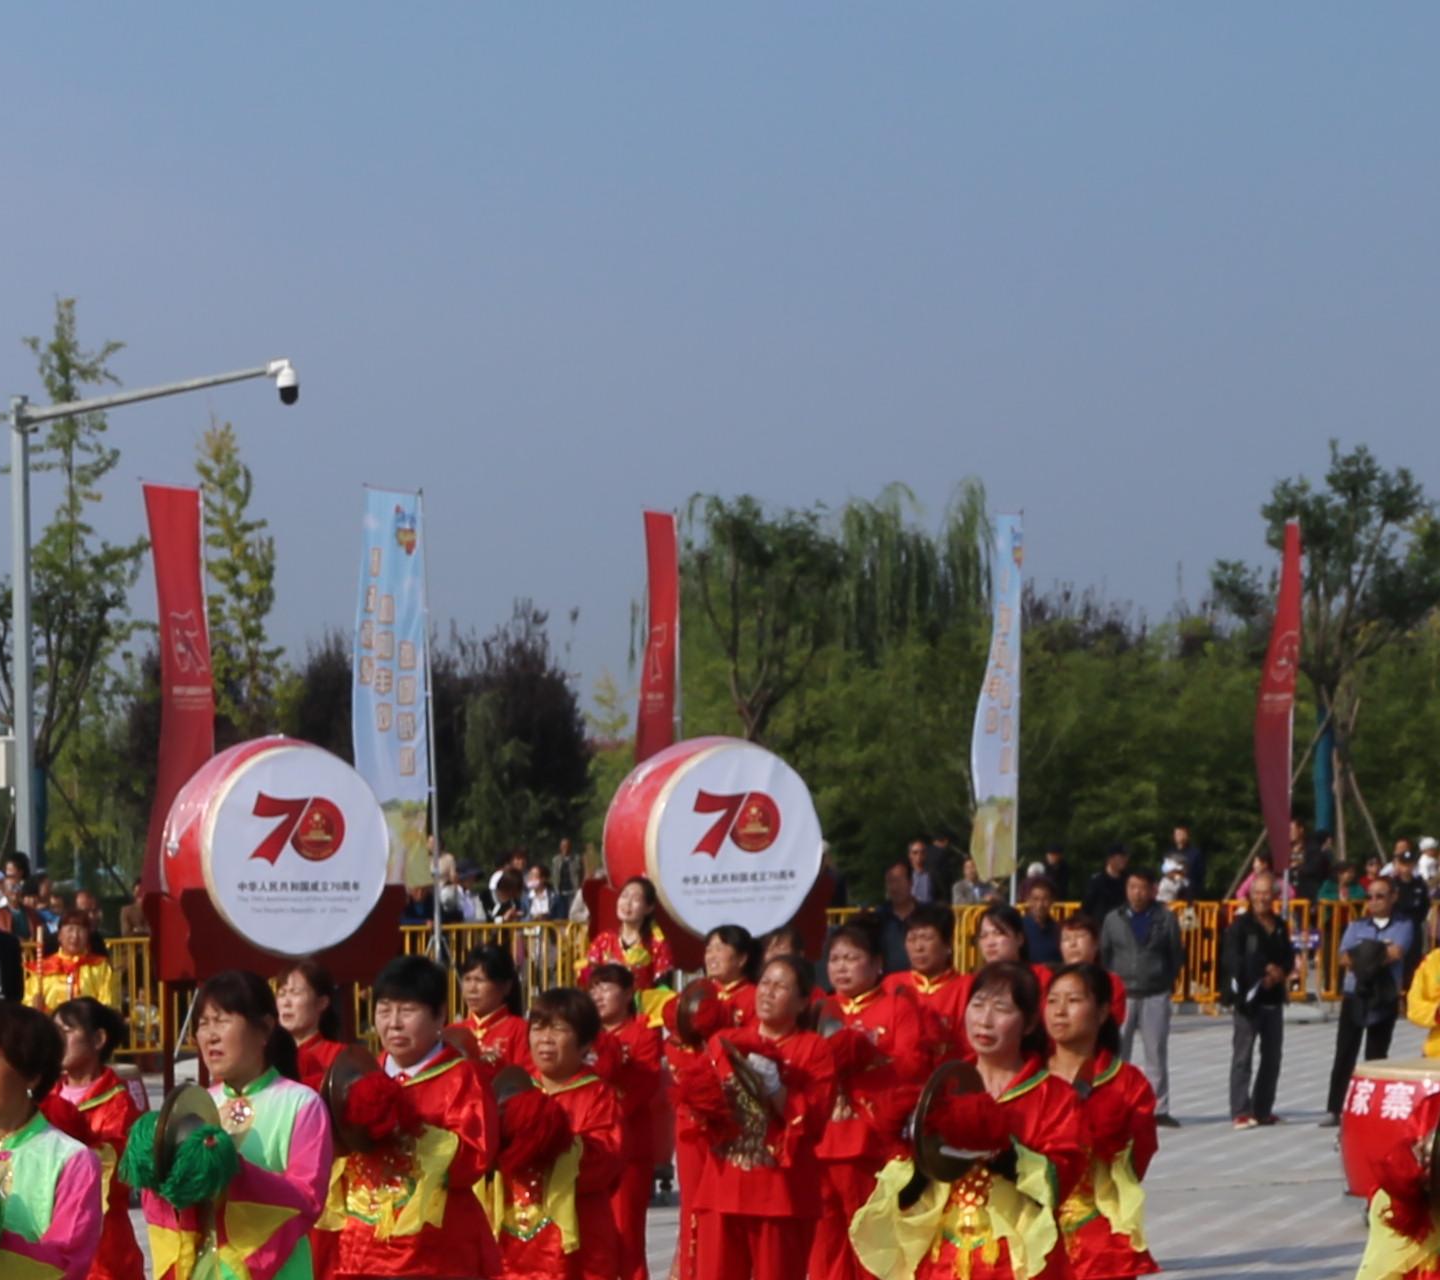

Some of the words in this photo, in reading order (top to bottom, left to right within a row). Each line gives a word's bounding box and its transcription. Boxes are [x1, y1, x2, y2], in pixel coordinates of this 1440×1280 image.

[248, 791, 345, 867] 70
[690, 788, 781, 859] 70
[1342, 1078, 1440, 1120] 家寨
